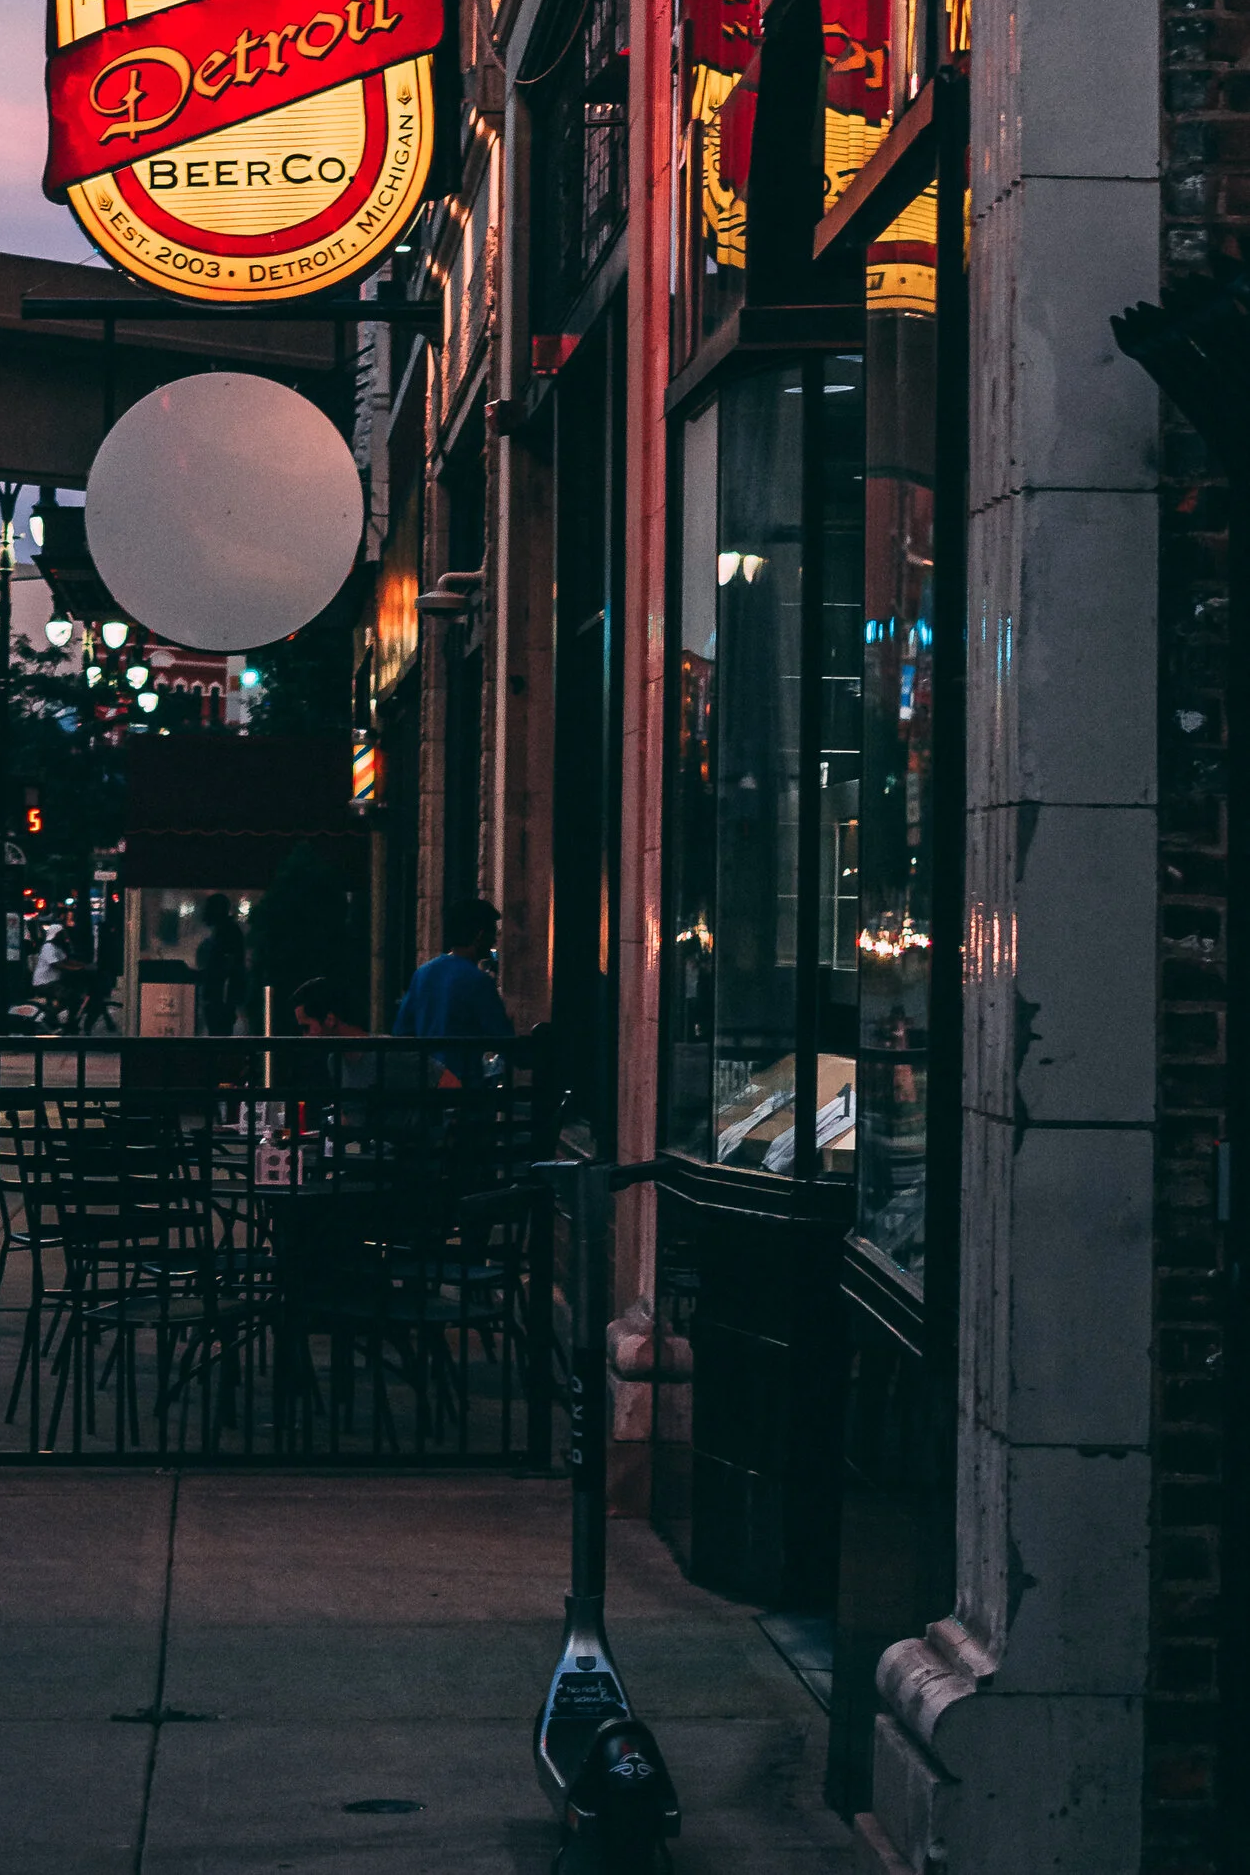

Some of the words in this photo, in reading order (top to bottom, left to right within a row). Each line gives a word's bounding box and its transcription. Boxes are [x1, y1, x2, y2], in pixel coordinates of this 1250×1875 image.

[148, 156, 272, 191] BEER
[109, 211, 152, 261] EST.
[154, 245, 221, 280] 2003
[248, 240, 359, 284] DETROIT,
[357, 112, 415, 233] MICHIGAN
[27, 807, 43, 833] 5
